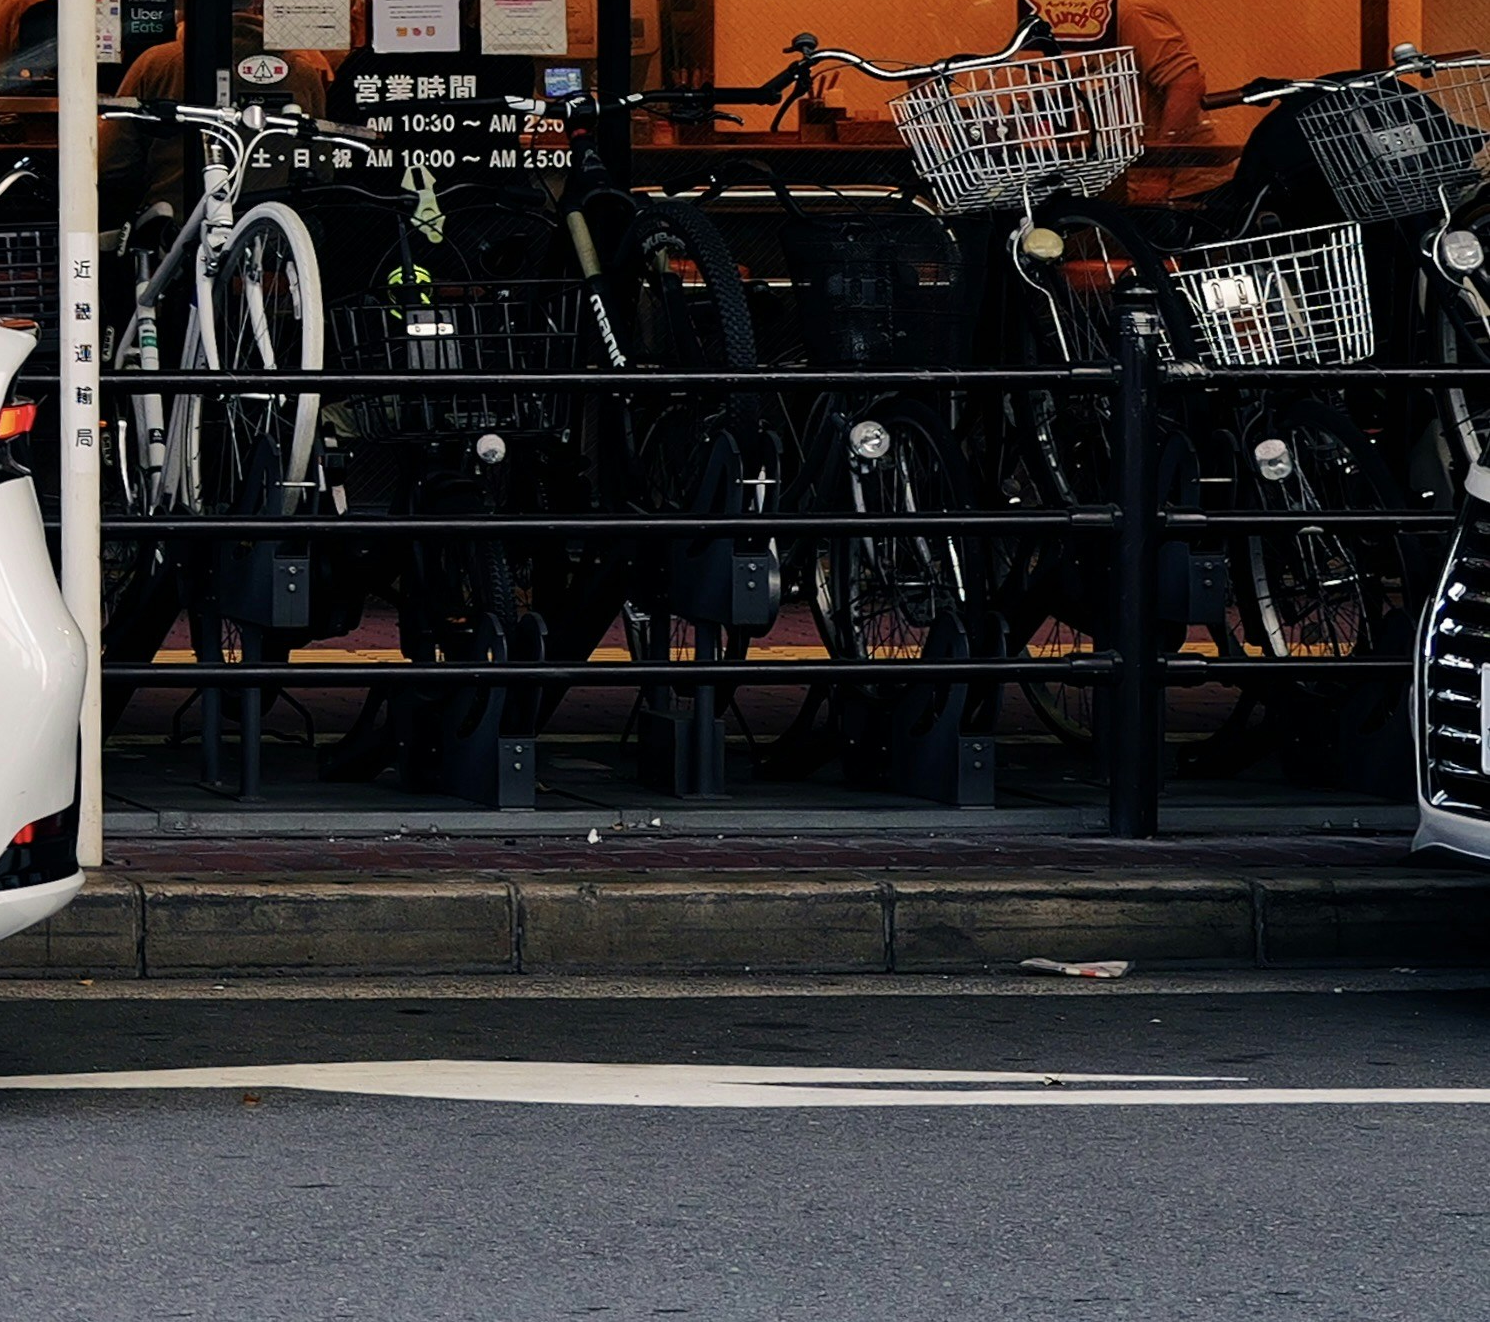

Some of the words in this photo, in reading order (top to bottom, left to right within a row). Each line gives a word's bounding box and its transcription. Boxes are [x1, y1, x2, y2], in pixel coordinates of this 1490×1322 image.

[131, 7, 162, 20] Uber
[1045, 7, 1090, 30] Lunch
[131, 21, 164, 33] Eats
[353, 75, 477, 104] 営業時間
[488, 115, 516, 132] AM
[366, 151, 393, 167] AM
[401, 149, 456, 167] 10:00
[488, 150, 516, 167] AM
[74, 259, 94, 449] 近畿運輸局
